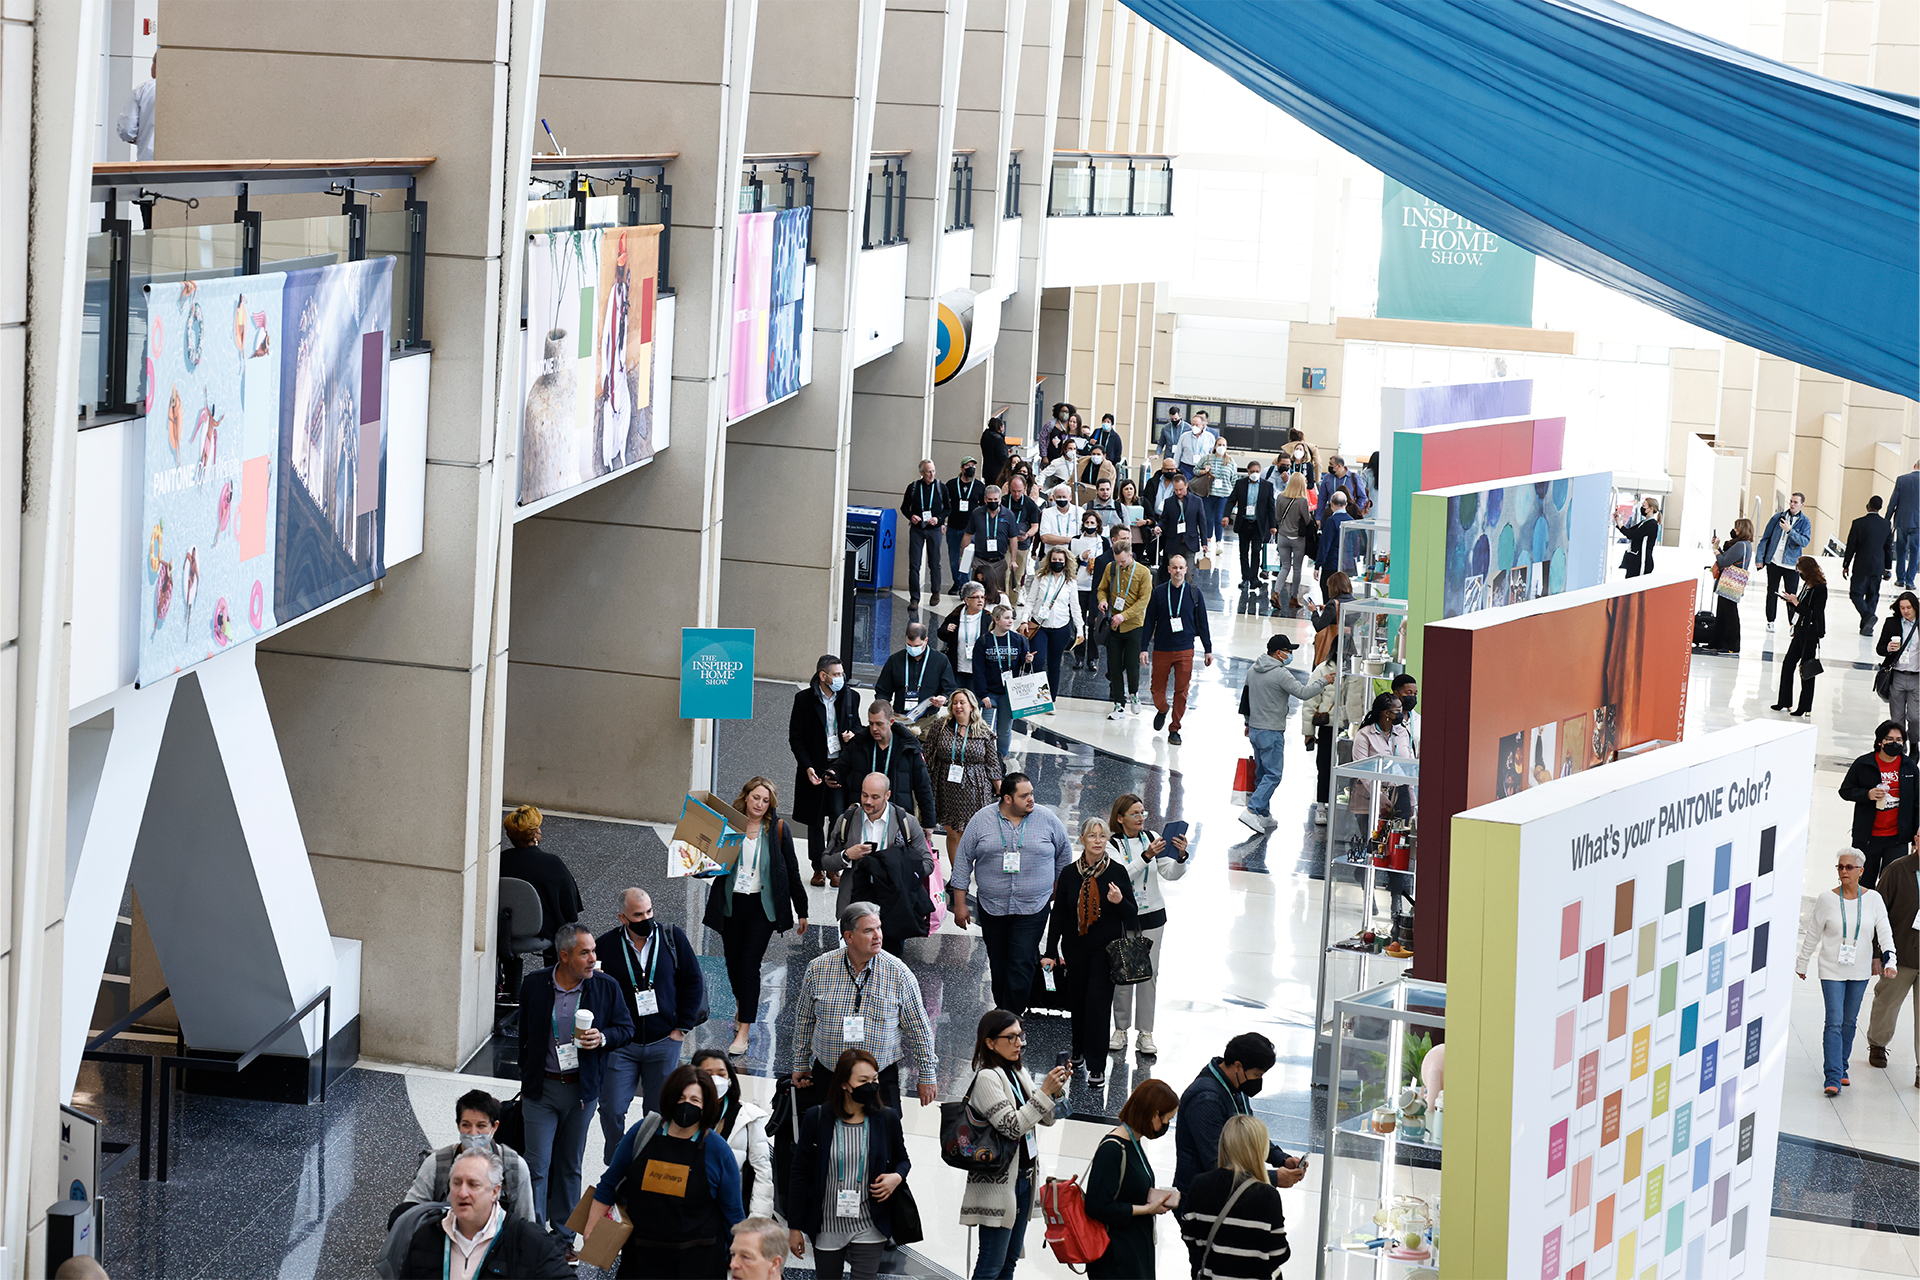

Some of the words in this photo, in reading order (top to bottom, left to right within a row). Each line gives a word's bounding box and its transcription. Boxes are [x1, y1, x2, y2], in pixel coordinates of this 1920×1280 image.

[1419, 229, 1499, 253] HOME
[1319, 375, 1326, 388] 4
[153, 463, 196, 498] PANTONE
[1682, 588, 1696, 677] ColorWatch
[692, 660, 743, 671] INSPIRED
[700, 654, 717, 662] THE
[700, 669, 736, 680] HOME
[1571, 823, 1620, 871] What's
[1622, 817, 1656, 859] your
[1658, 786, 1724, 838] PANTONE
[1728, 770, 1772, 813] Color?
